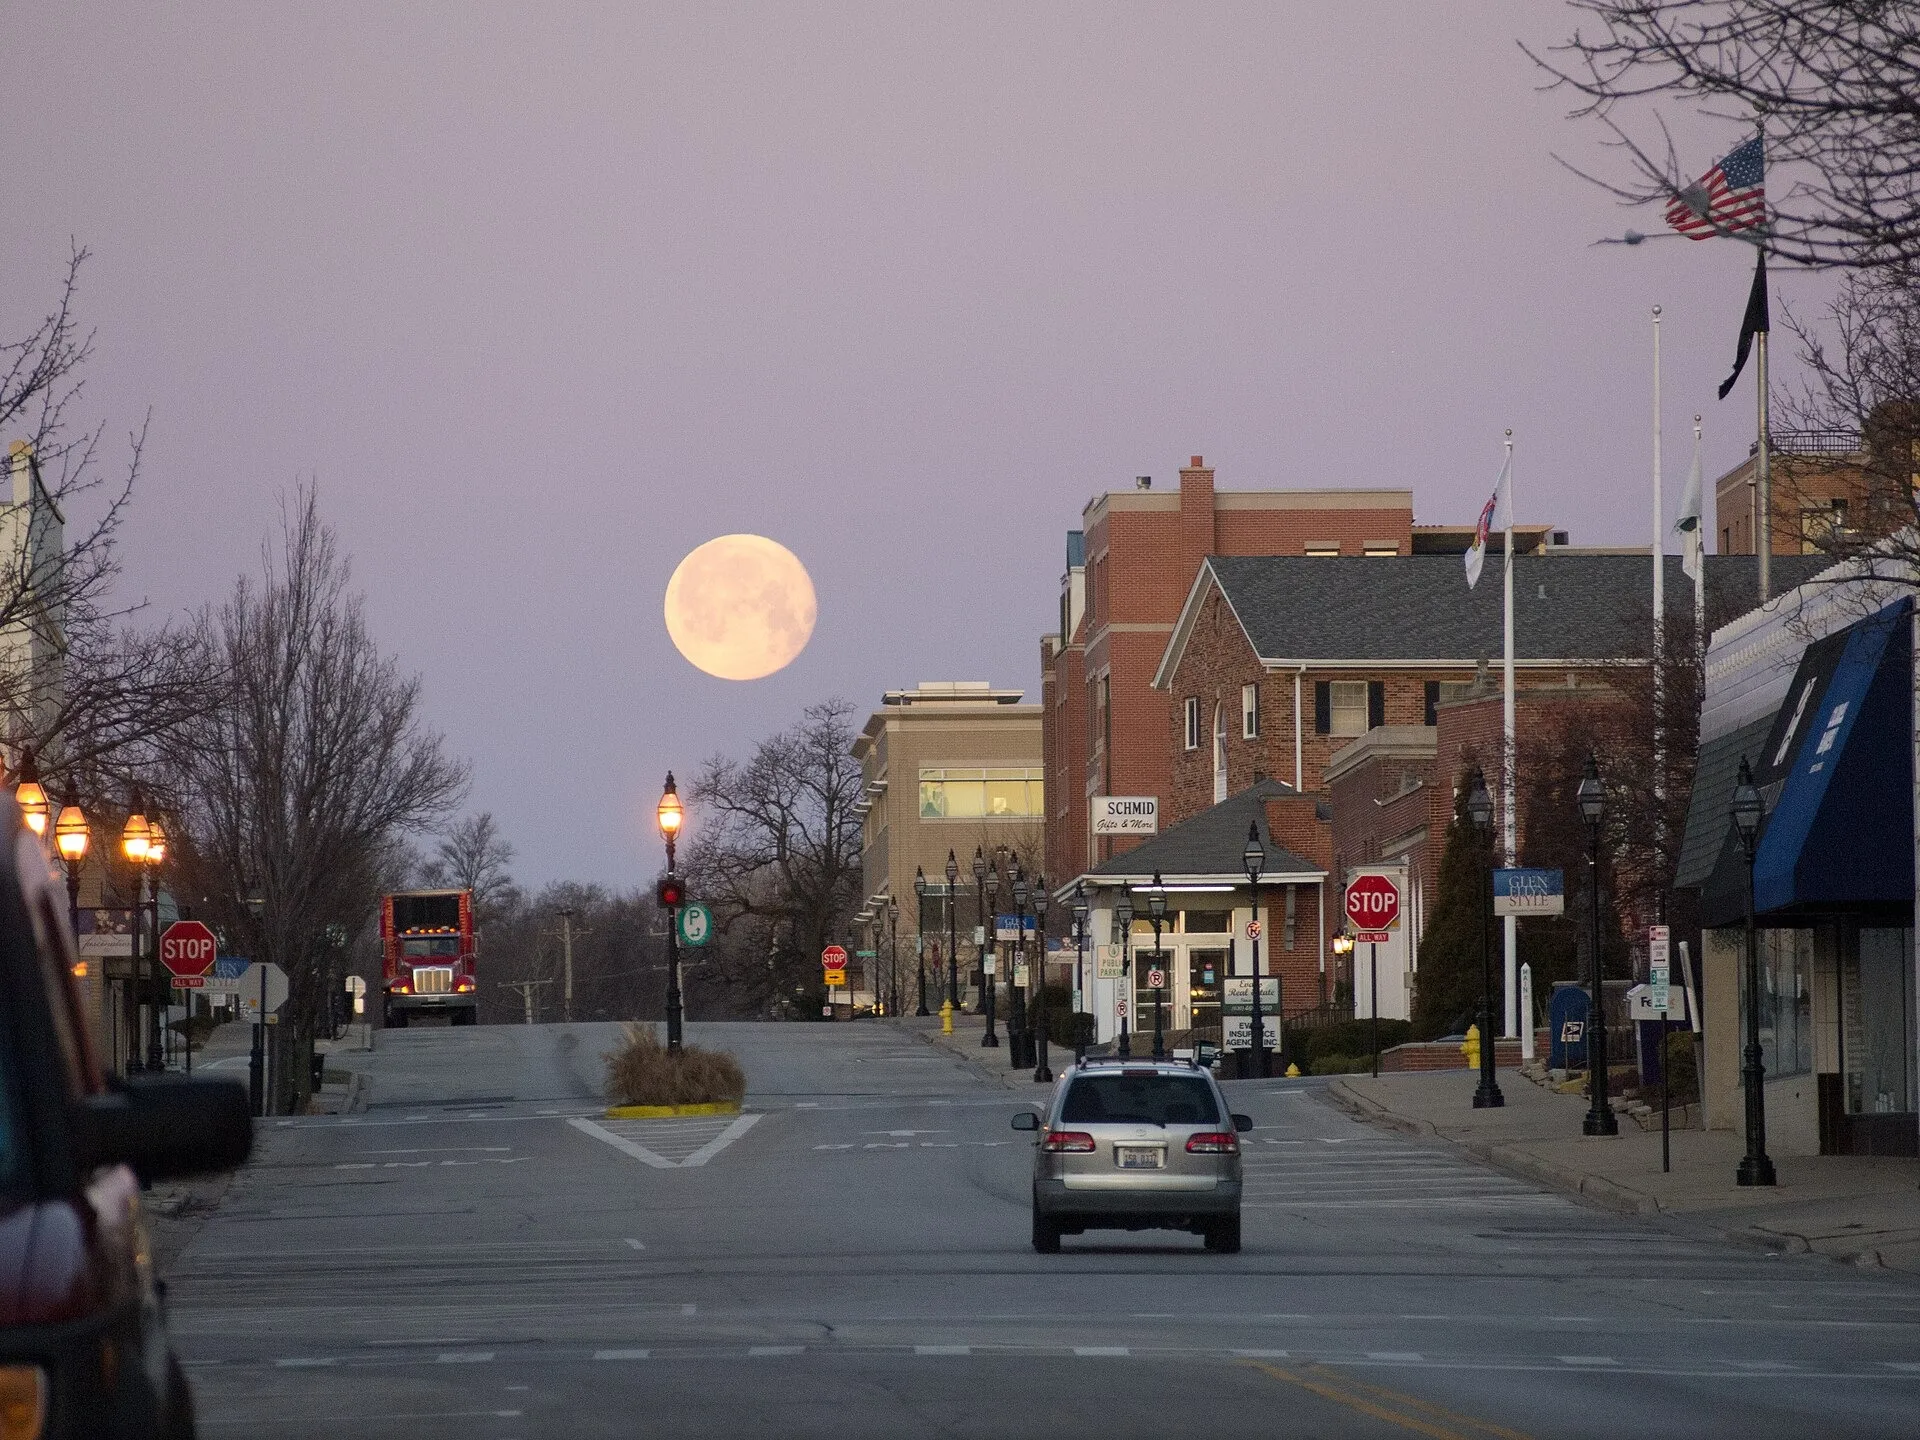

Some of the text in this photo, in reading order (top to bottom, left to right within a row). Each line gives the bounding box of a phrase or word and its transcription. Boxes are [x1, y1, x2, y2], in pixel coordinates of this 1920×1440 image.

[1108, 802, 1155, 815] SCHMID
[1097, 818, 1153, 831] Gifts & More
[1508, 875, 1548, 888] GLEN
[1509, 886, 1548, 896] ELLYN
[1349, 892, 1396, 913] STOP
[1509, 895, 1549, 907] STYLE
[689, 909, 700, 925] P
[1358, 933, 1387, 941] ALL WAY
[164, 938, 212, 959] STOP
[823, 953, 845, 963] STOP
[1102, 959, 1123, 967] PUBLI
[1100, 968, 1123, 976] PARKIN
[174, 979, 203, 987] ALL WAY
[1239, 980, 1263, 988] Evas
[1228, 988, 1275, 997] Real Etate
[1640, 996, 1675, 1008] Fex
[1229, 1030, 1275, 1038] INSURCE
[1225, 1038, 1280, 1046] AGENC INC.
